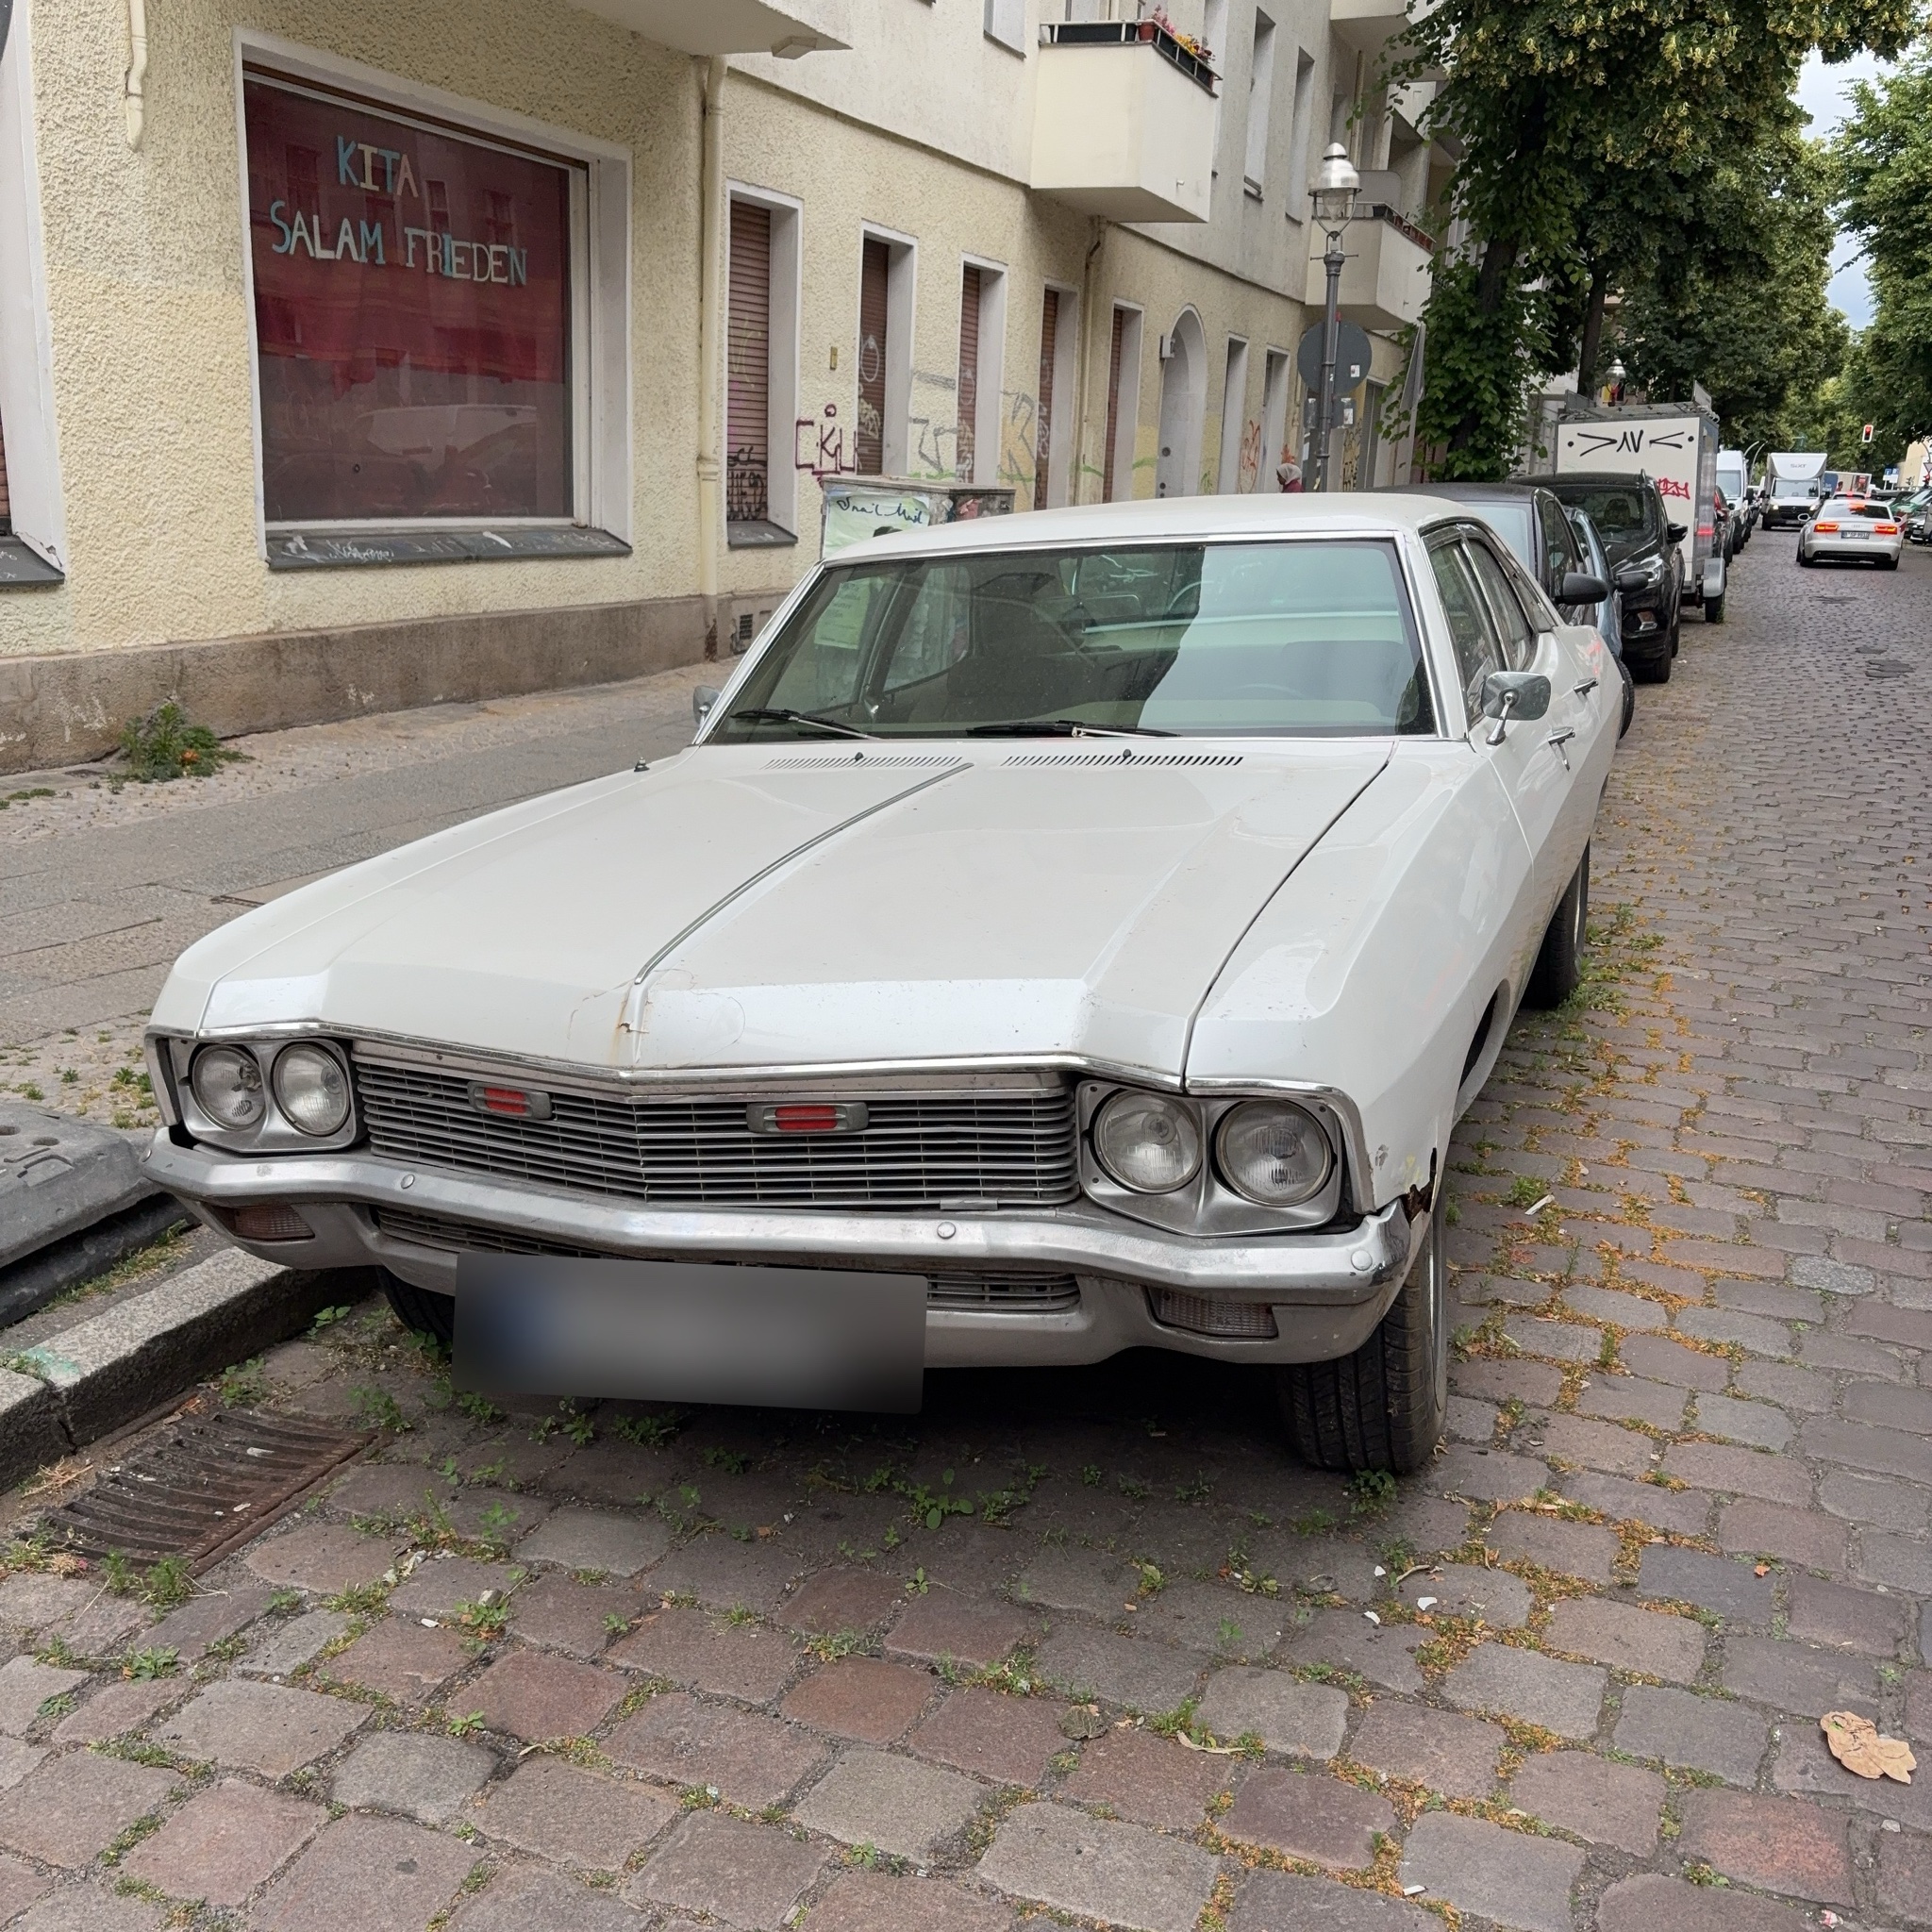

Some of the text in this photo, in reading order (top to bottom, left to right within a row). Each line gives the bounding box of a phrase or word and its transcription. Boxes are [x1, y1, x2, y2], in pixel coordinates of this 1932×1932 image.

[337, 135, 419, 198] KITA
[270, 200, 527, 287] SALAM FRIEDEN
[837, 496, 883, 516] Snail
